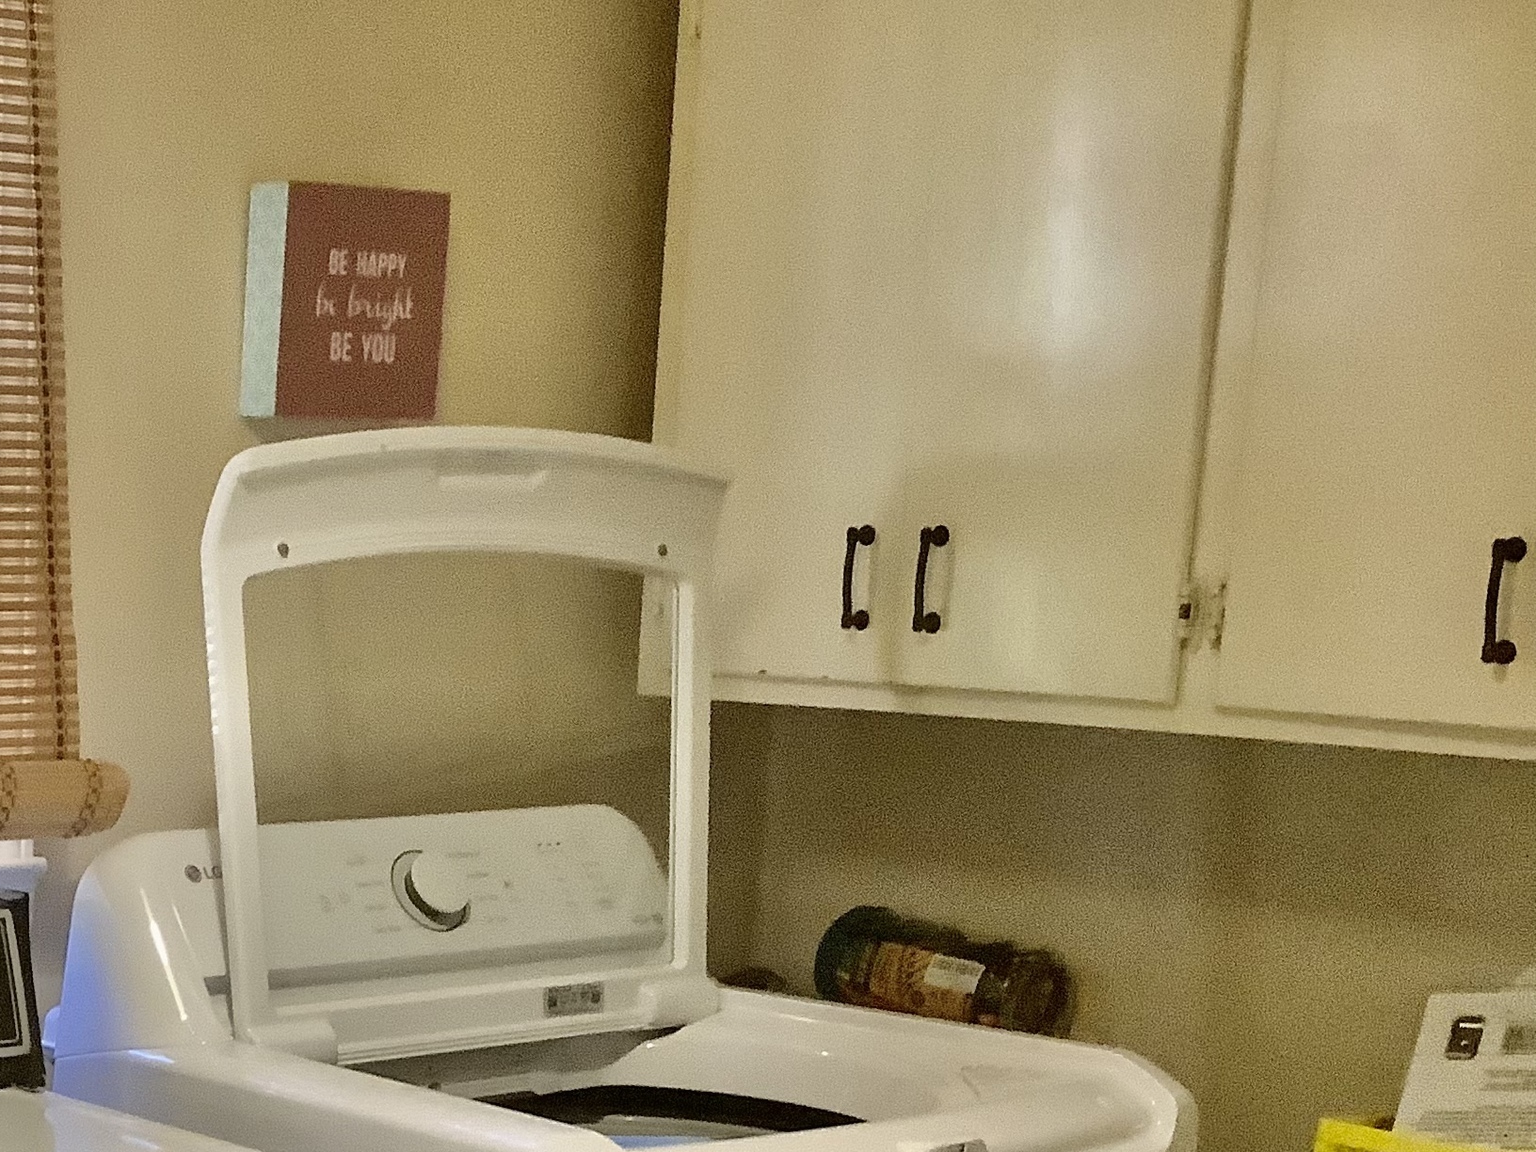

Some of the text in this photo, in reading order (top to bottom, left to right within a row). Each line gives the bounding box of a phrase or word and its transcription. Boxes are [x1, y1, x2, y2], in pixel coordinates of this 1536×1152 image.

[329, 248, 406, 278] BE HAPPY
[348, 284, 413, 331] bright
[330, 331, 395, 364] BE YOU
